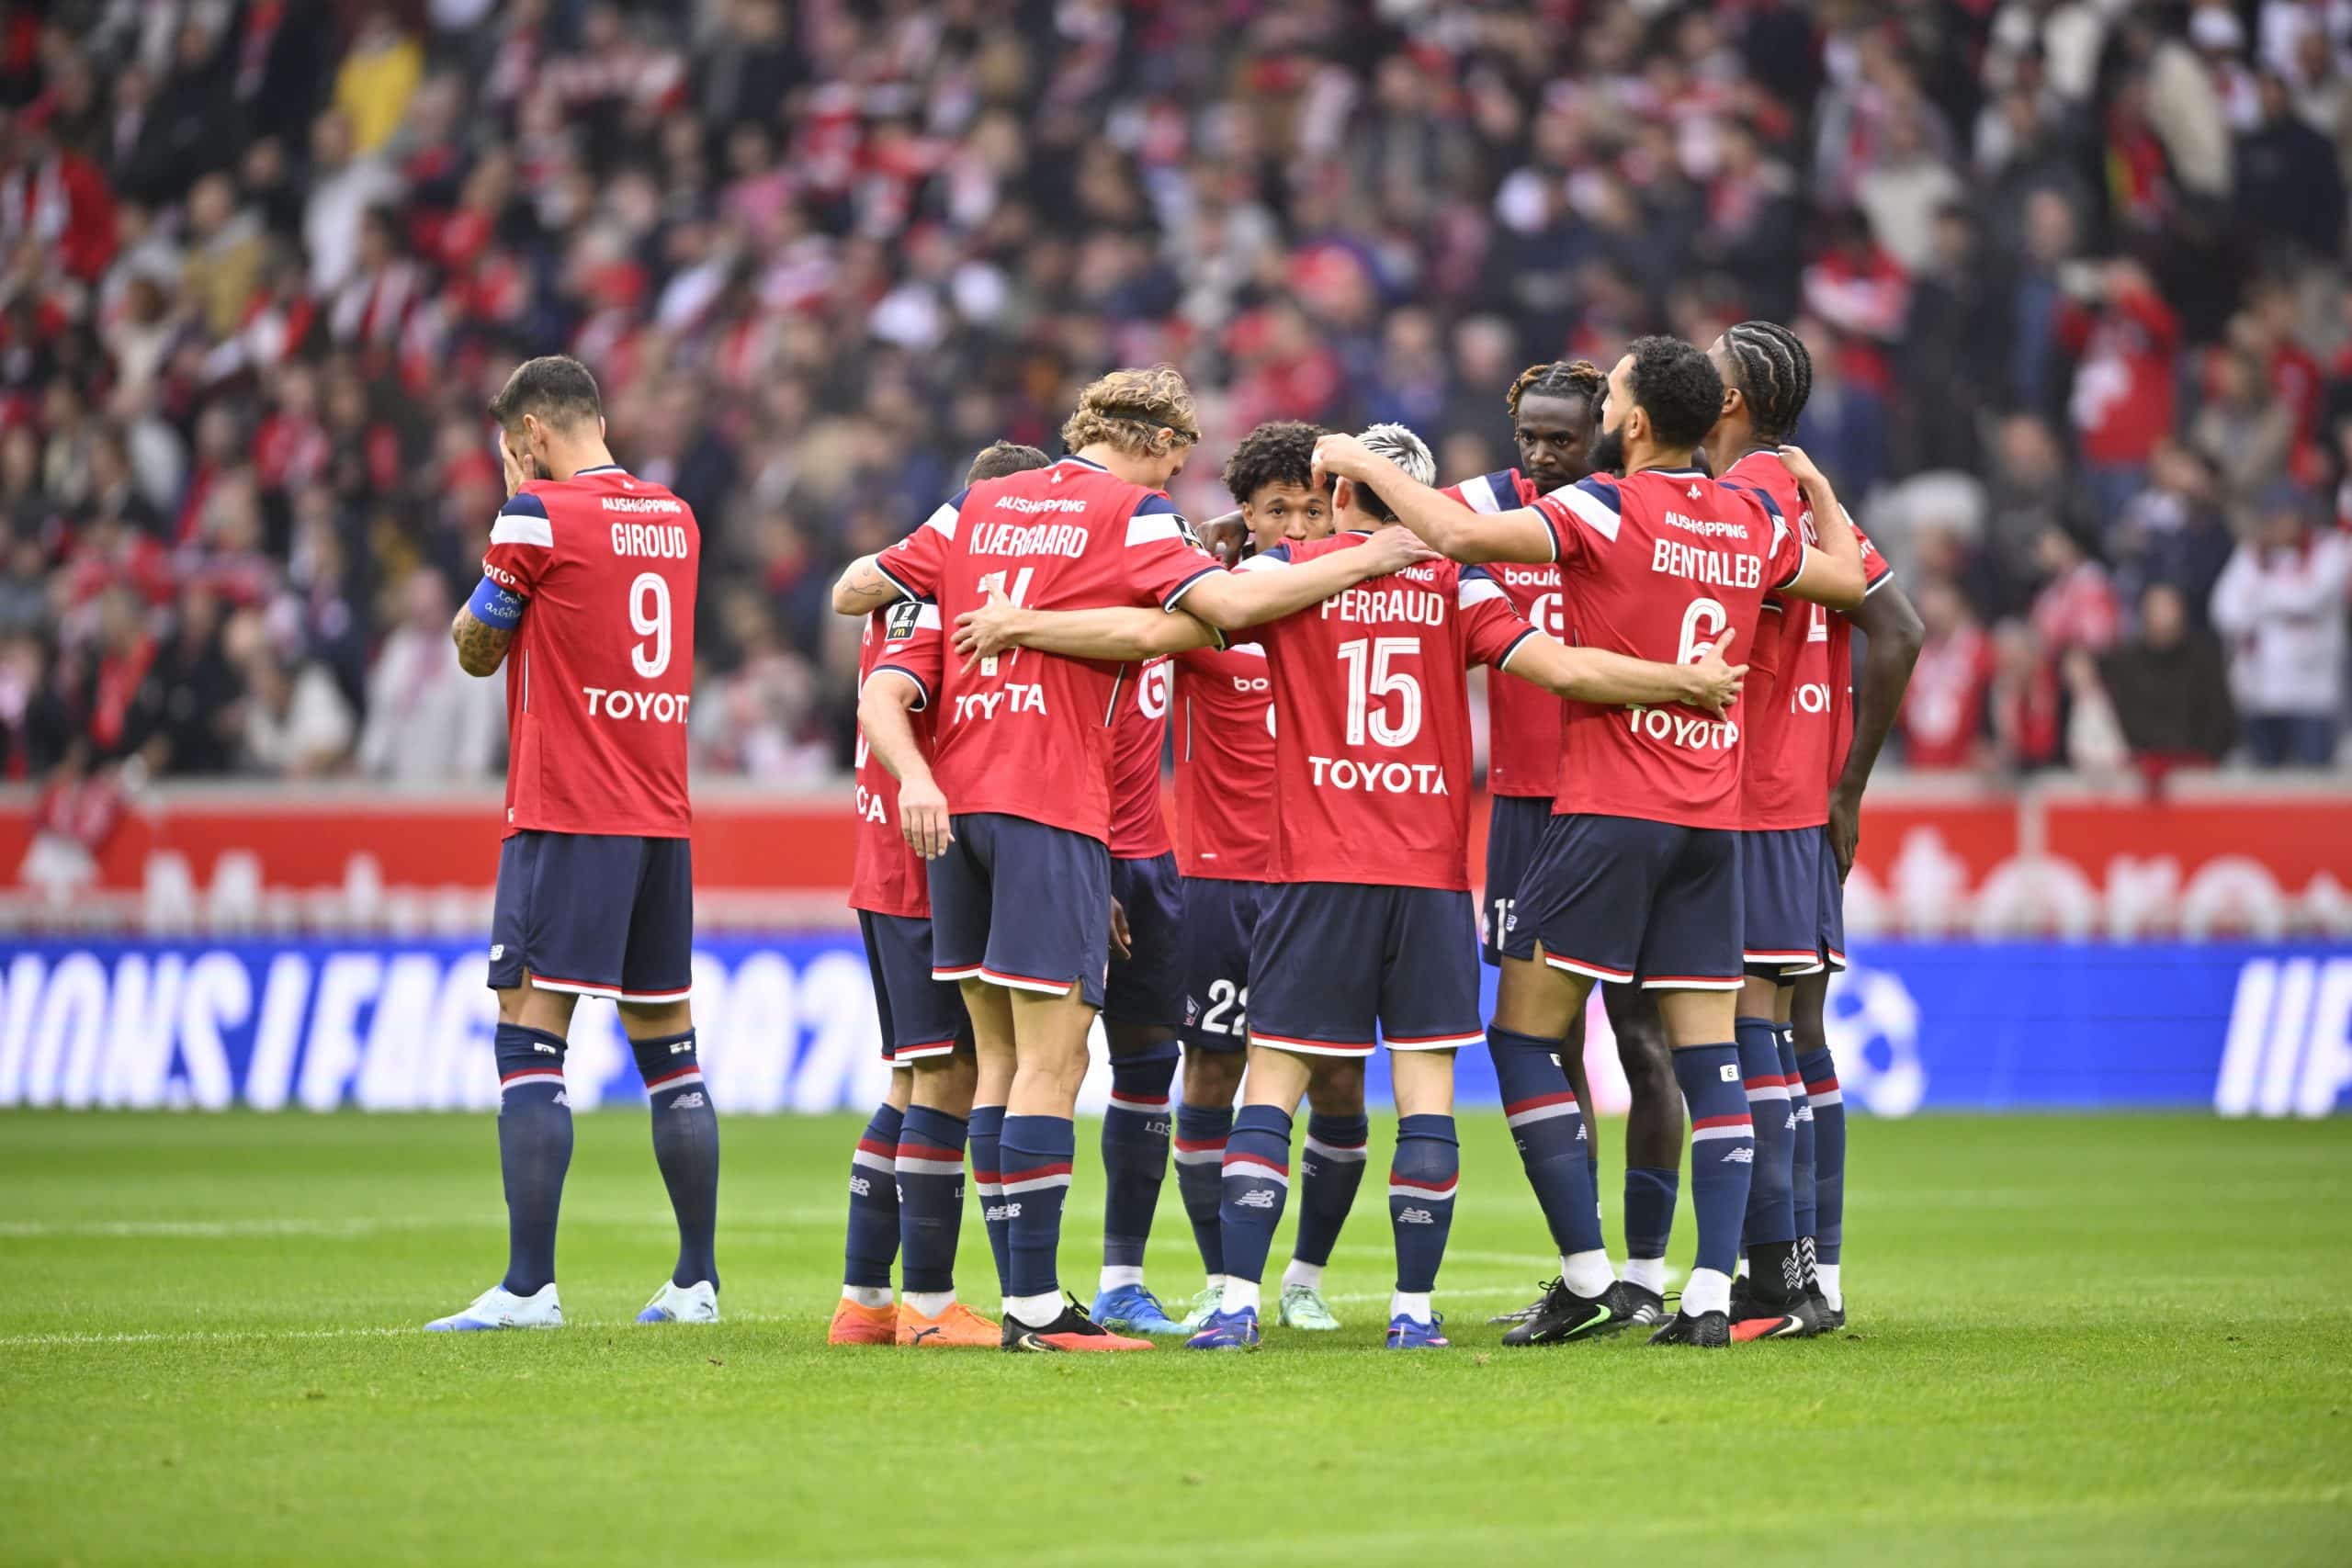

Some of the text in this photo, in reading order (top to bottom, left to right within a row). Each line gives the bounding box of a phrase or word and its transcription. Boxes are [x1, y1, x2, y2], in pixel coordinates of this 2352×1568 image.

[611, 522, 687, 558] GIROUD
[1652, 537, 1761, 589] BENTALEB
[629, 572, 671, 678] 9
[1321, 589, 1444, 627] PERRAUD
[1678, 597, 1729, 705] 6
[582, 688, 689, 723] TOYOT
[954, 683, 1047, 725] TOYTA
[1338, 637, 1422, 747] 15
